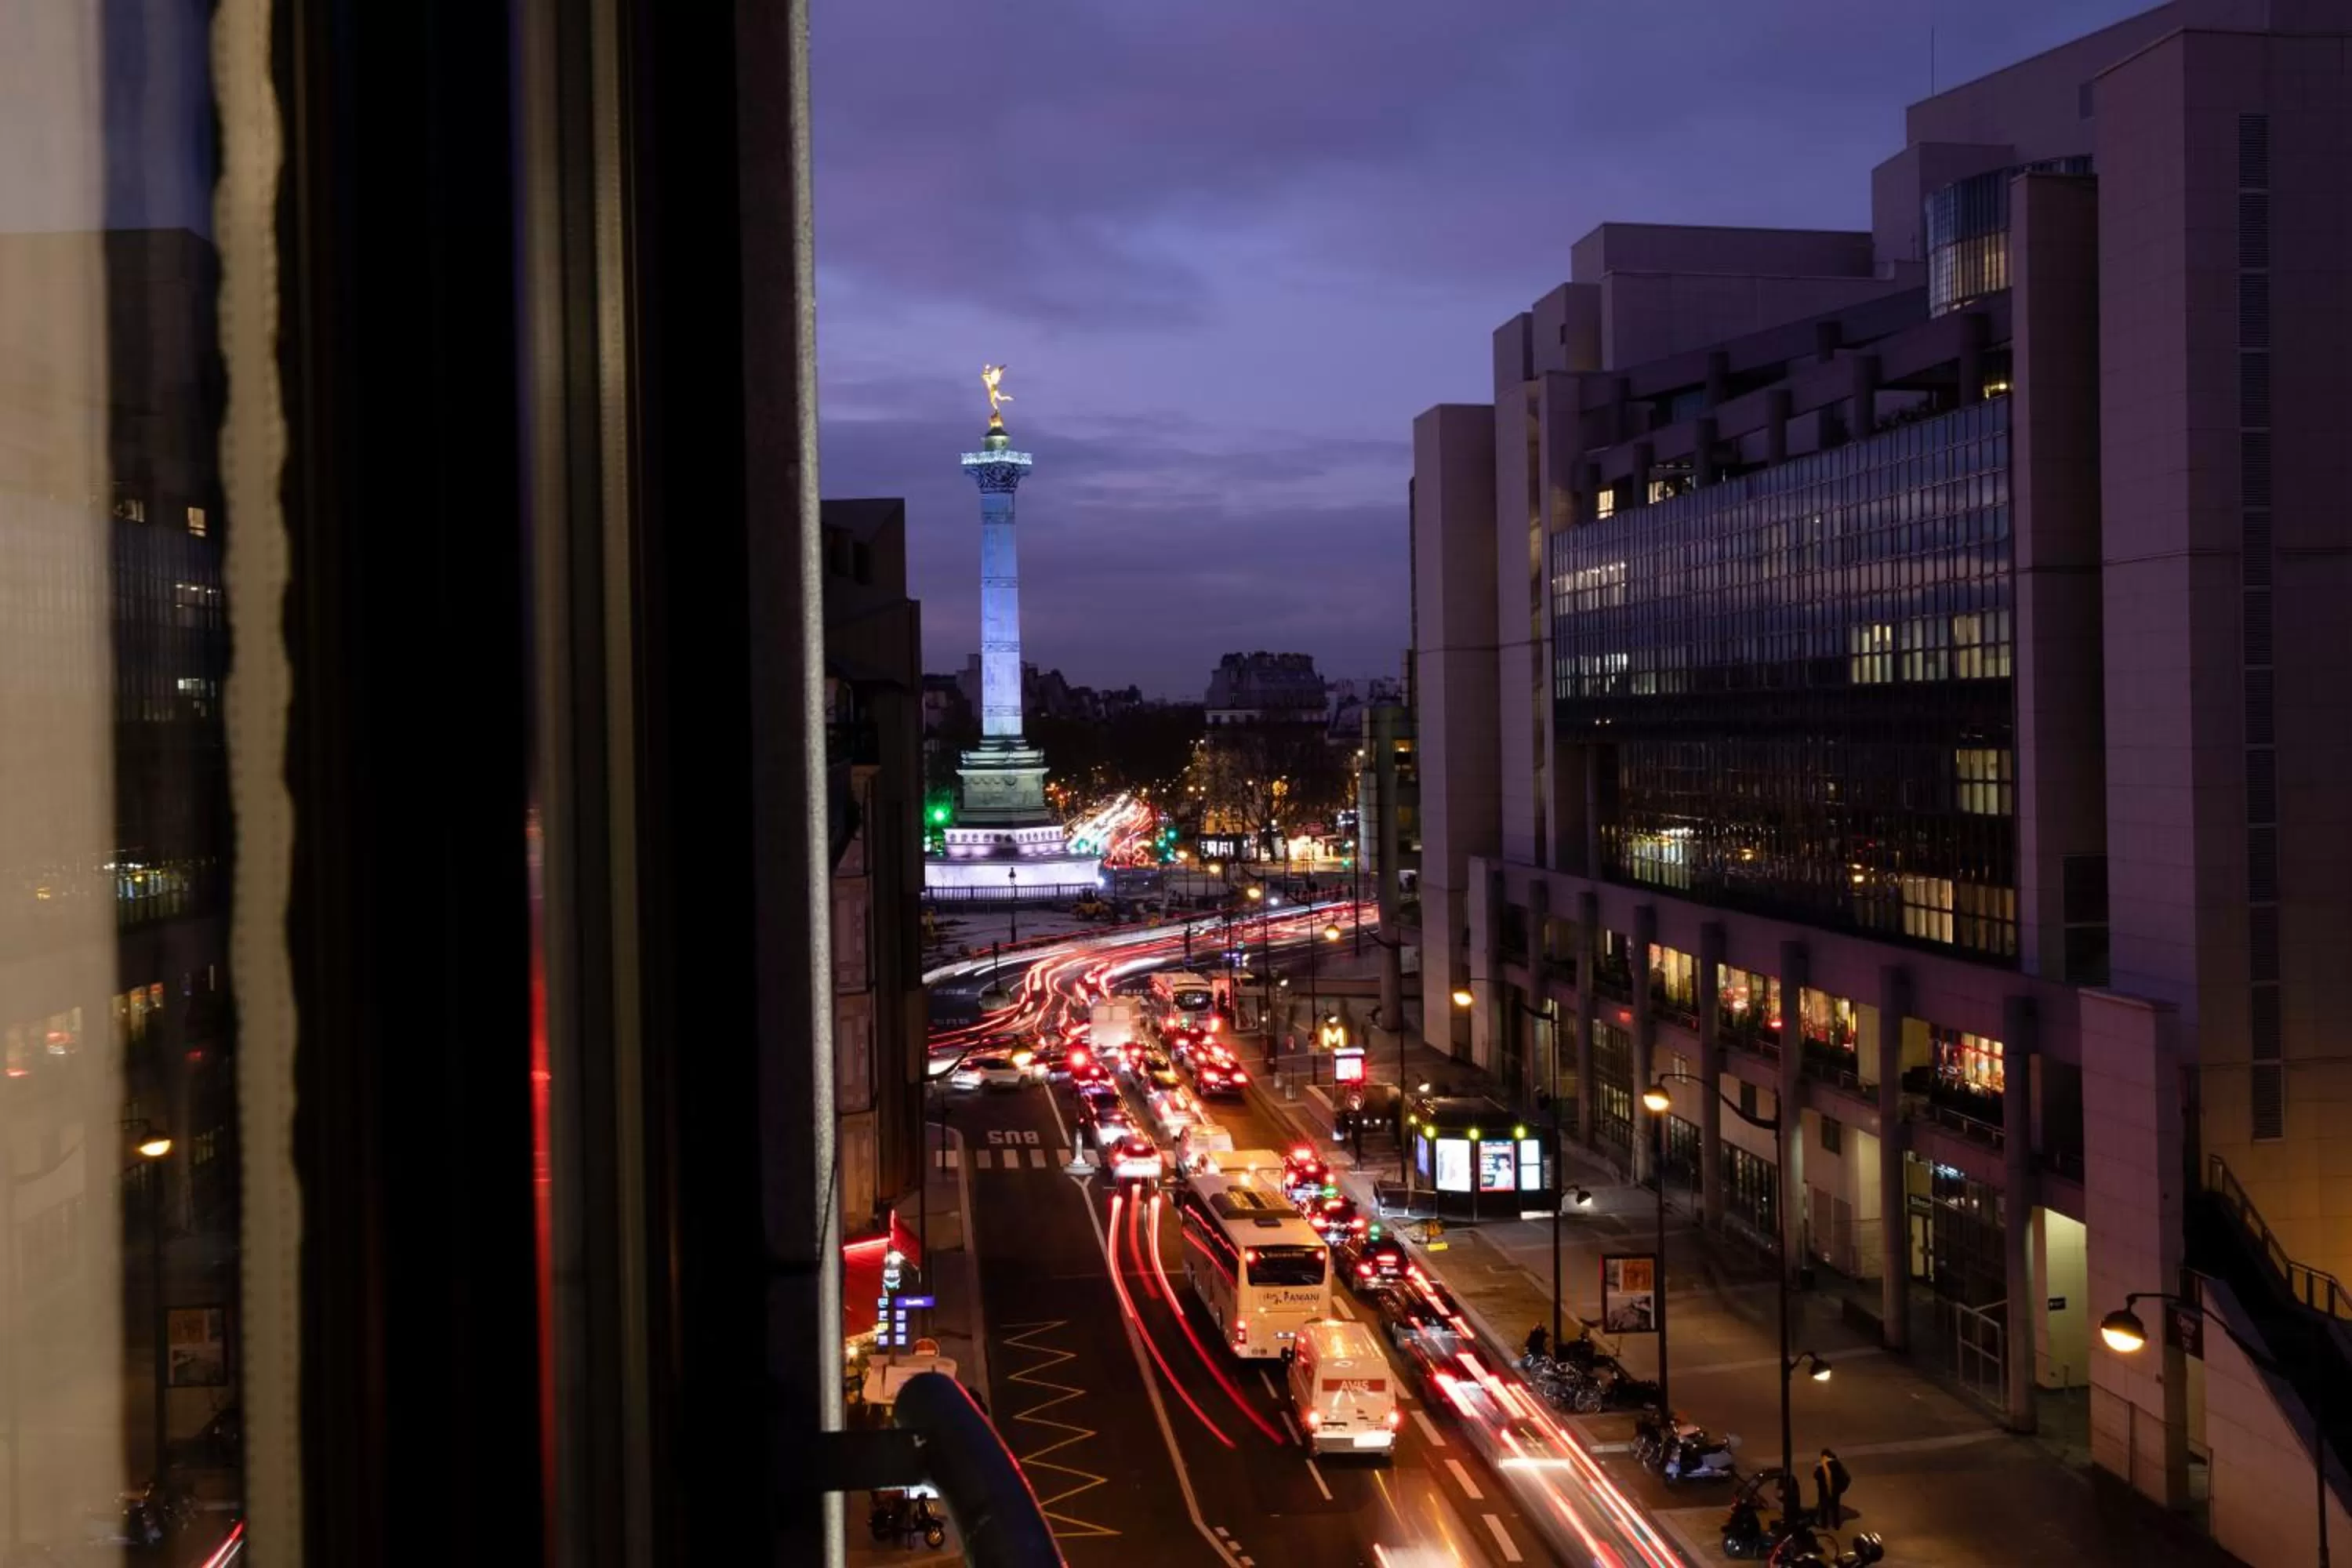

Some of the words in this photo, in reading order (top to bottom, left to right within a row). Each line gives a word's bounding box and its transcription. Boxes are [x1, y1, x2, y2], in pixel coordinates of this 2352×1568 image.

[1323, 1026, 1345, 1048] M
[986, 1130, 1040, 1145] BUS
[1341, 1380, 1370, 1390] AVIS
